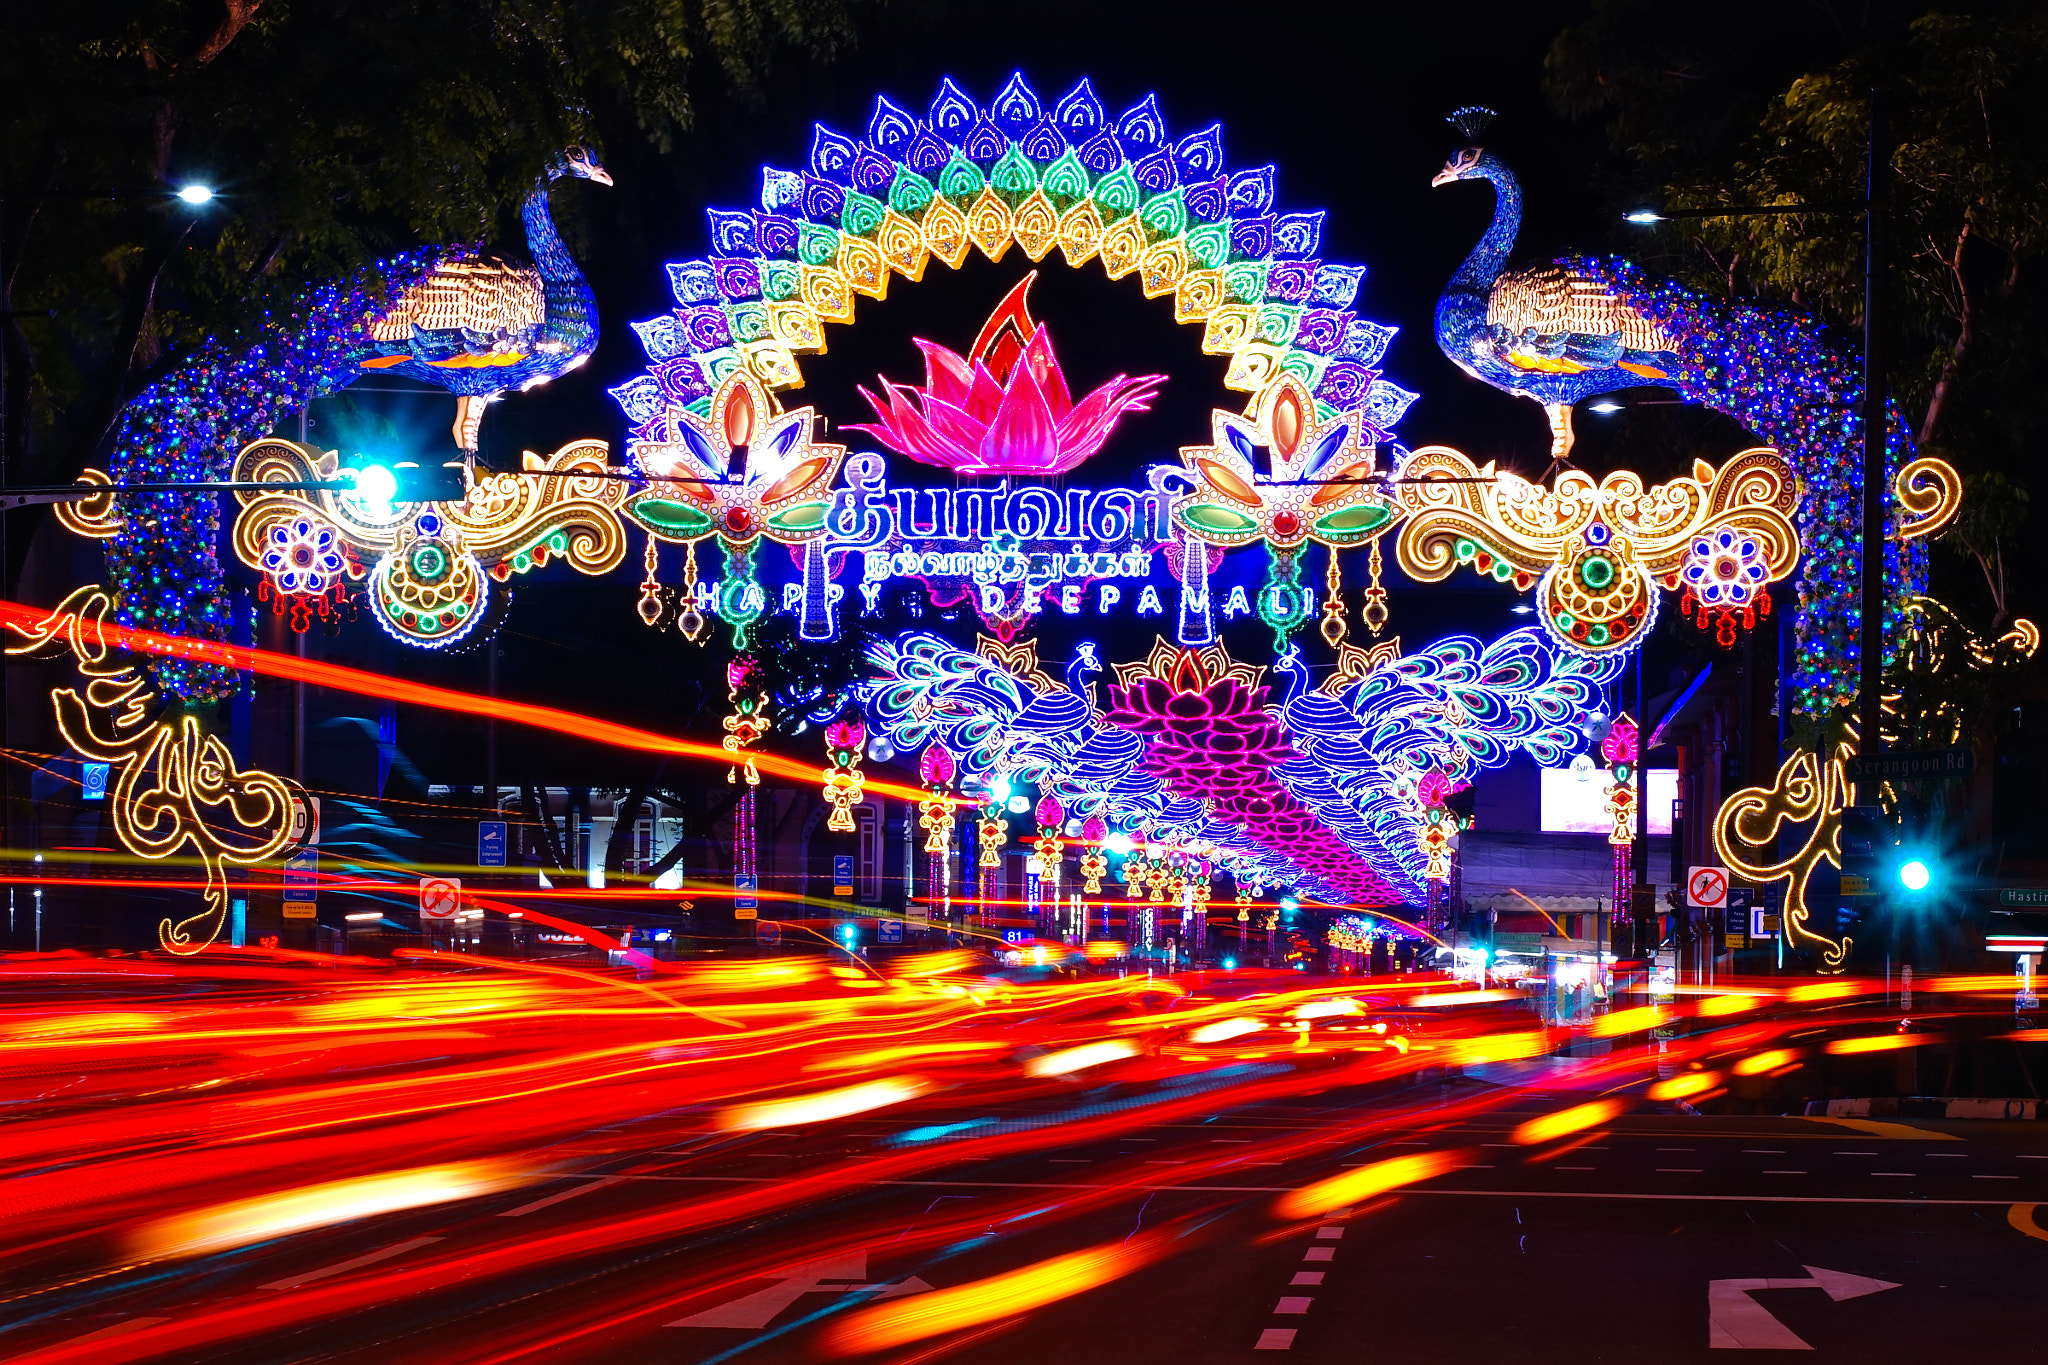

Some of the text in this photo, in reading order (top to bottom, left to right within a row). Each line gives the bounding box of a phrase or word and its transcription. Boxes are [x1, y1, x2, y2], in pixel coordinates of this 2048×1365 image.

[824, 452, 1197, 552] தீபாவளி
[864, 544, 1152, 587] நல்வாழ்த்துக்கள்
[698, 582, 1315, 614] HAPPY DEEPAVALI
[1855, 752, 1965, 776] Serangoon Rd
[1007, 931, 1022, 942] 81
